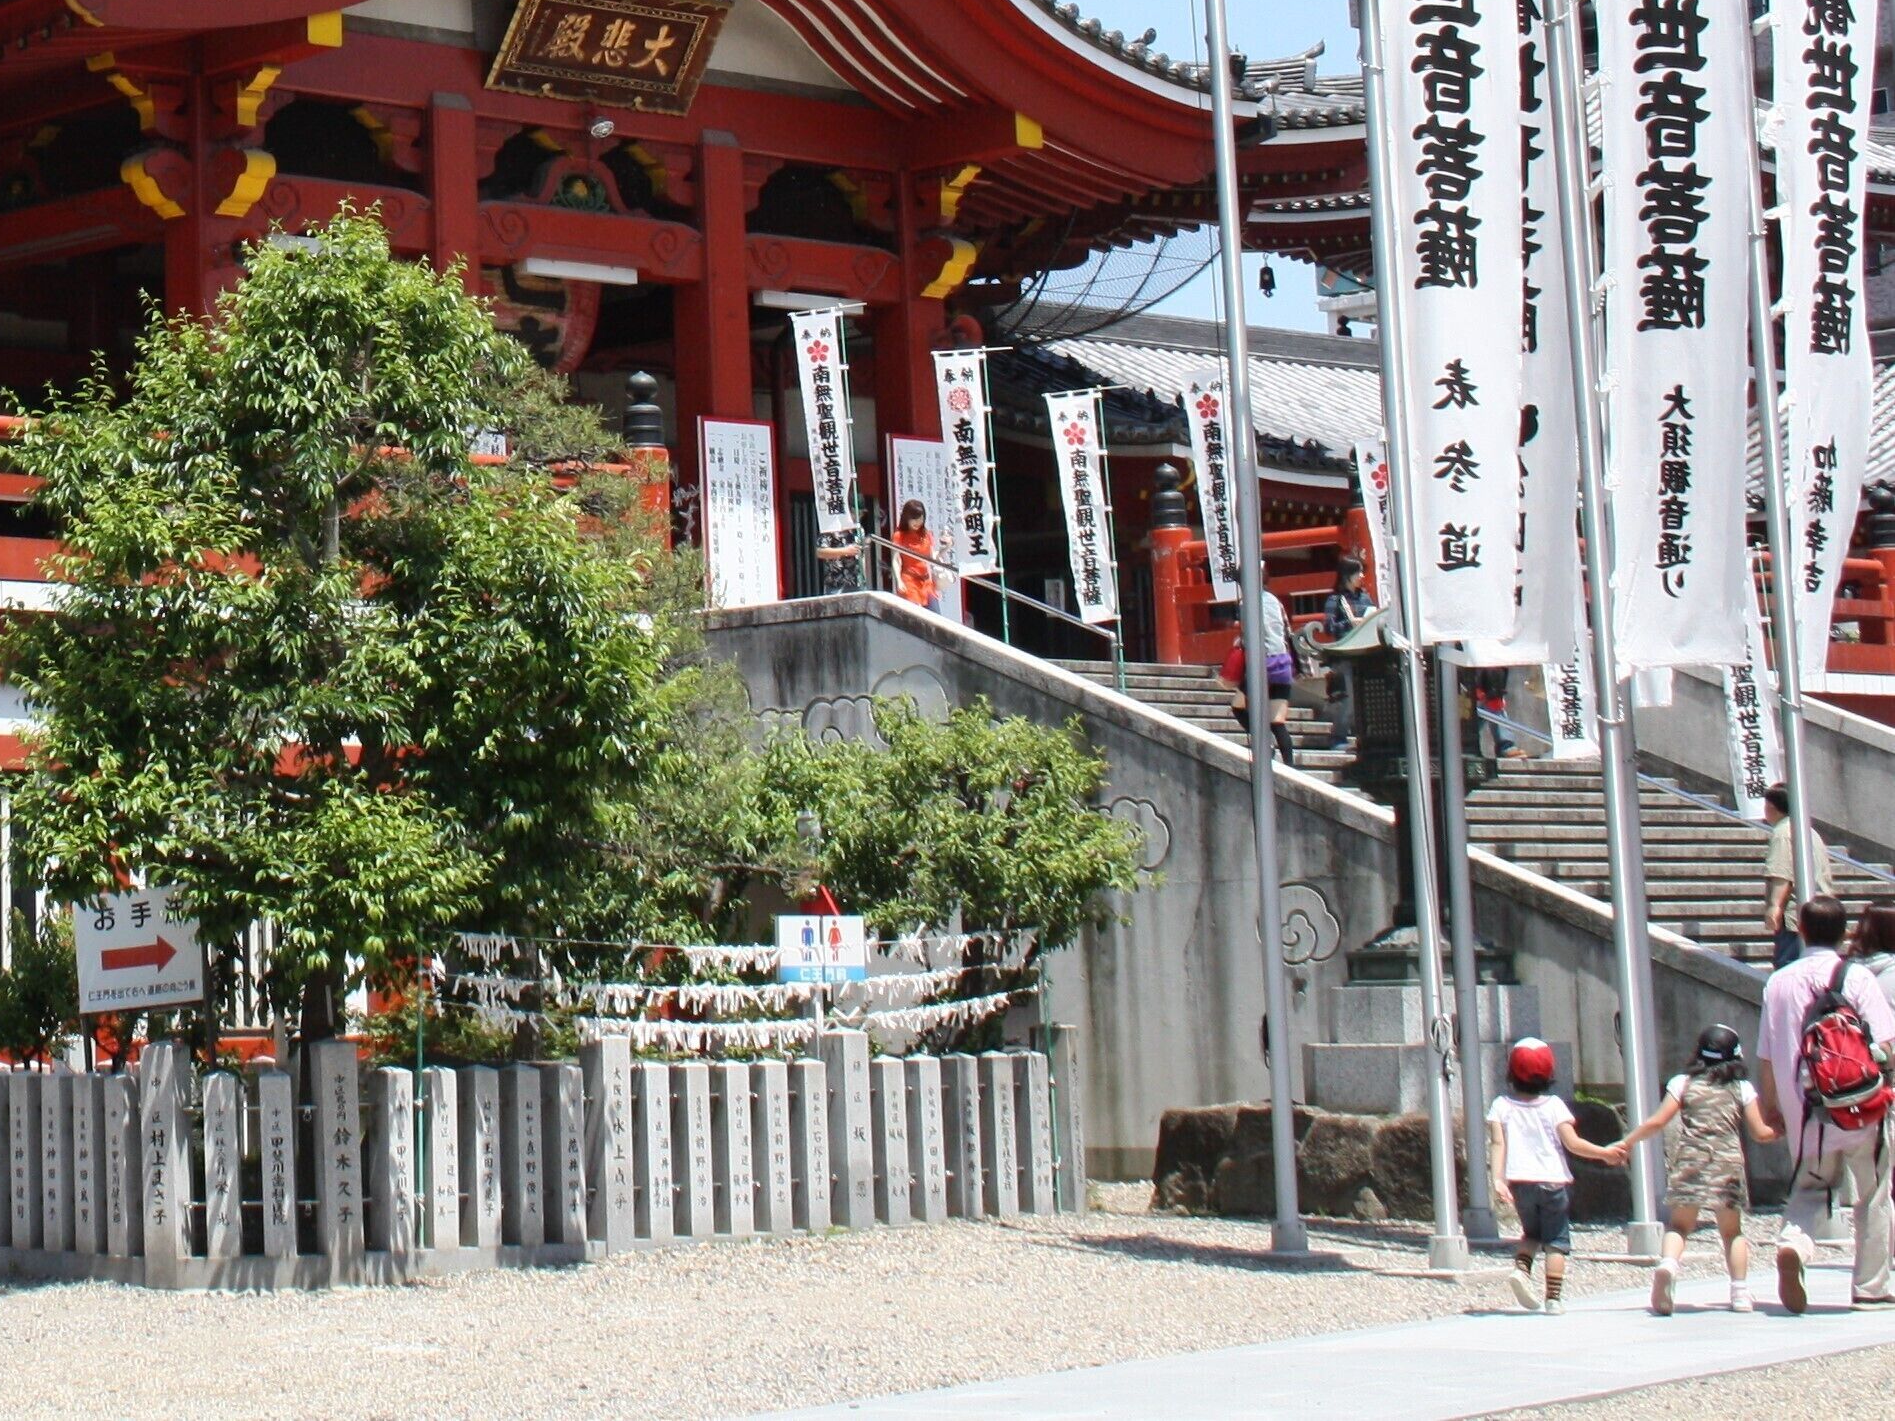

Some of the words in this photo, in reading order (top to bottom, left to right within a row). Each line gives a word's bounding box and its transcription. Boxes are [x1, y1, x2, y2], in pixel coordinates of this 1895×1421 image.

[943, 366, 975, 385] 奉納
[952, 417, 989, 558] 南無不動明王
